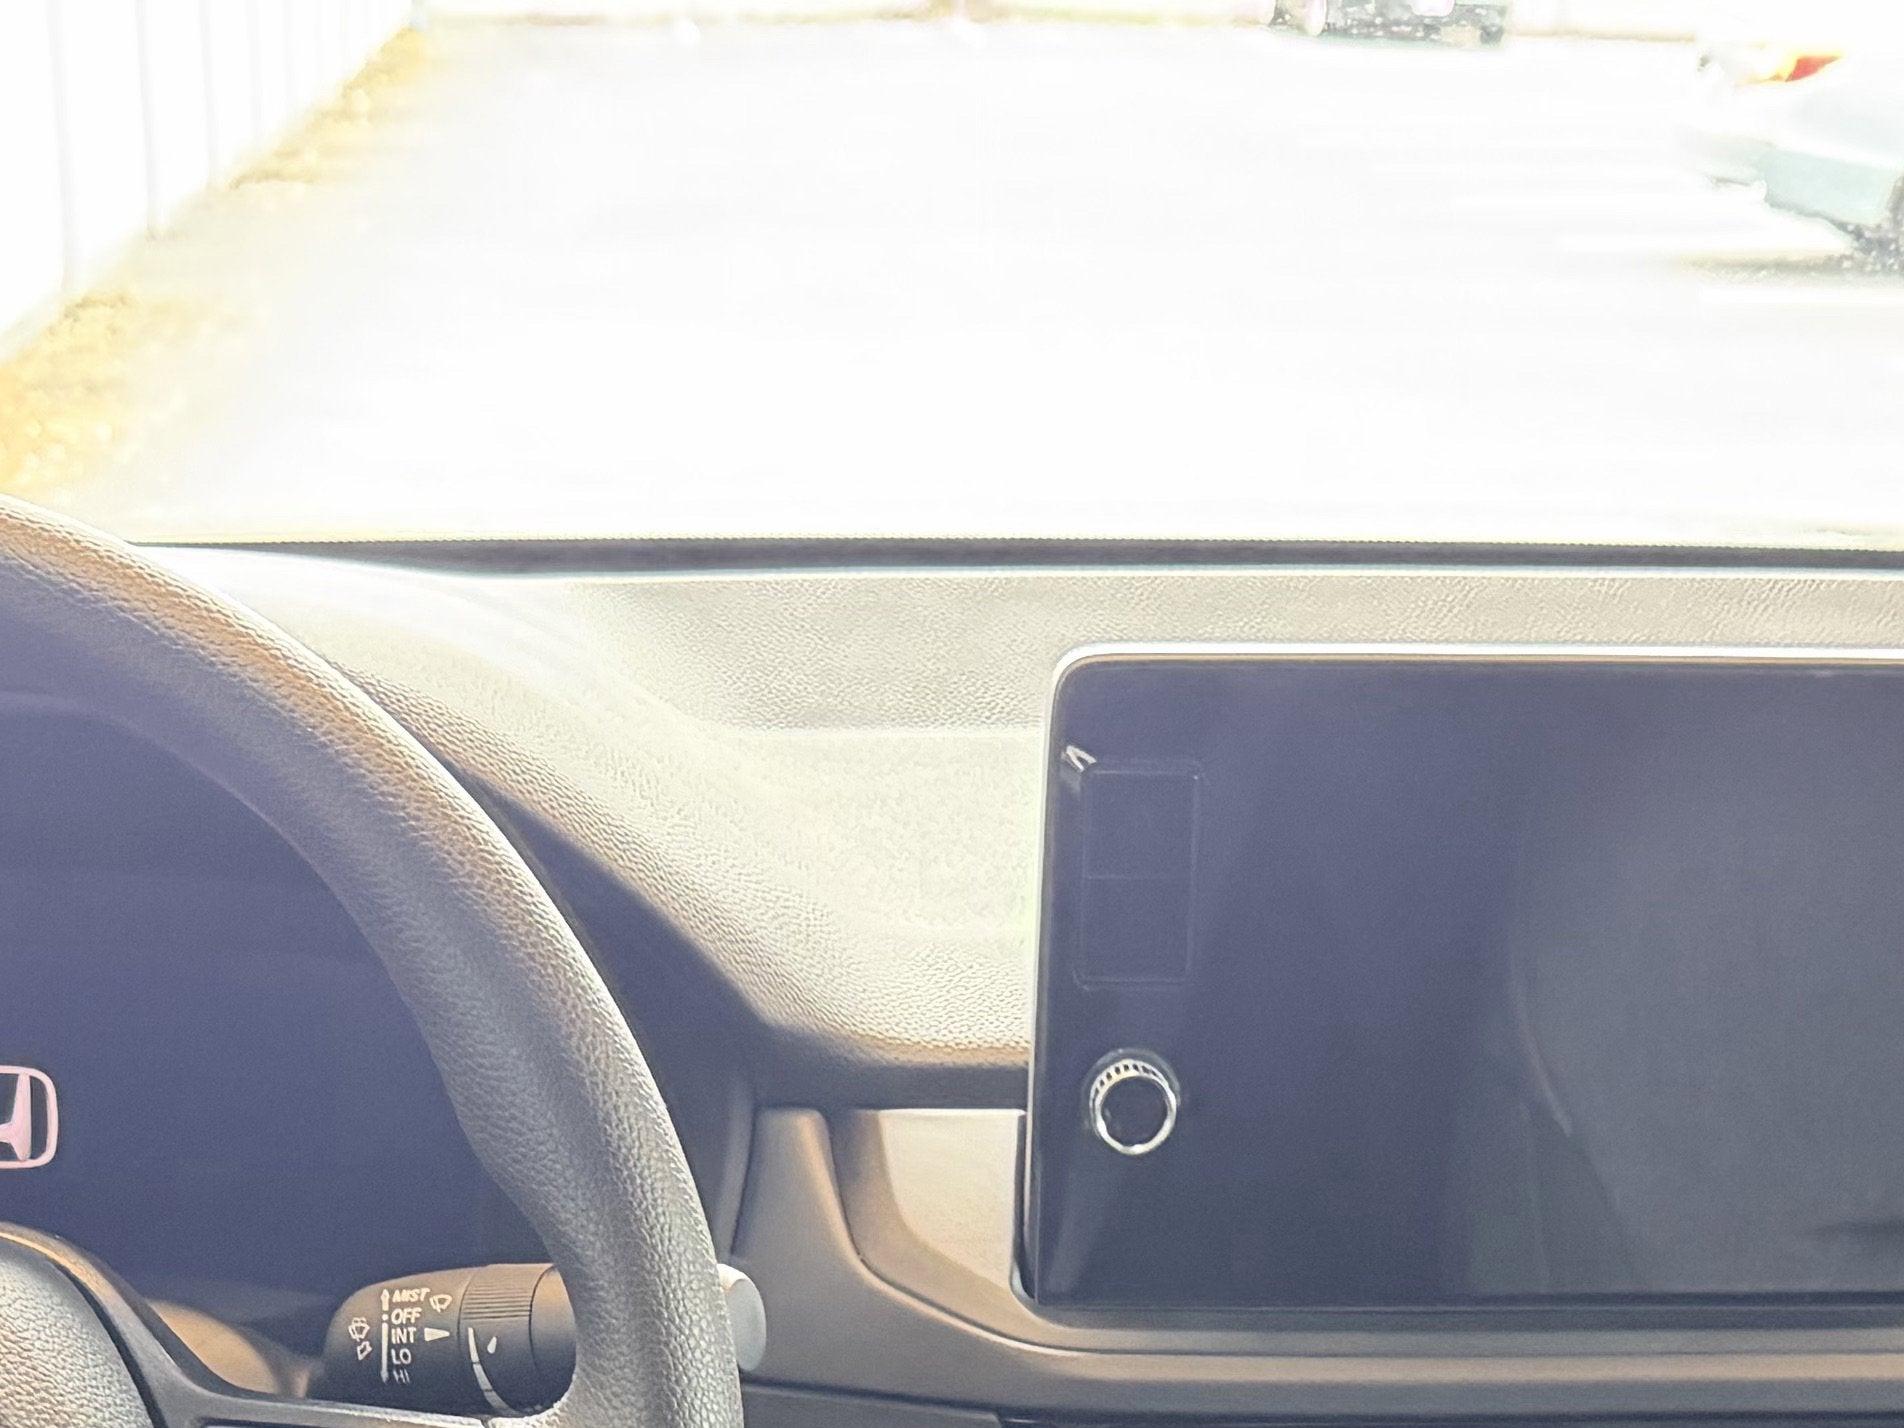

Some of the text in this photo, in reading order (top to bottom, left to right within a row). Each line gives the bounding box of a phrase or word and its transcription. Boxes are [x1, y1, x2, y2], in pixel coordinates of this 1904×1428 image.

[392, 1287, 431, 1303] MIST
[391, 1307, 422, 1325] OFF
[391, 1327, 417, 1344] INT
[391, 1348, 412, 1365] LO
[393, 1368, 411, 1384] HI
